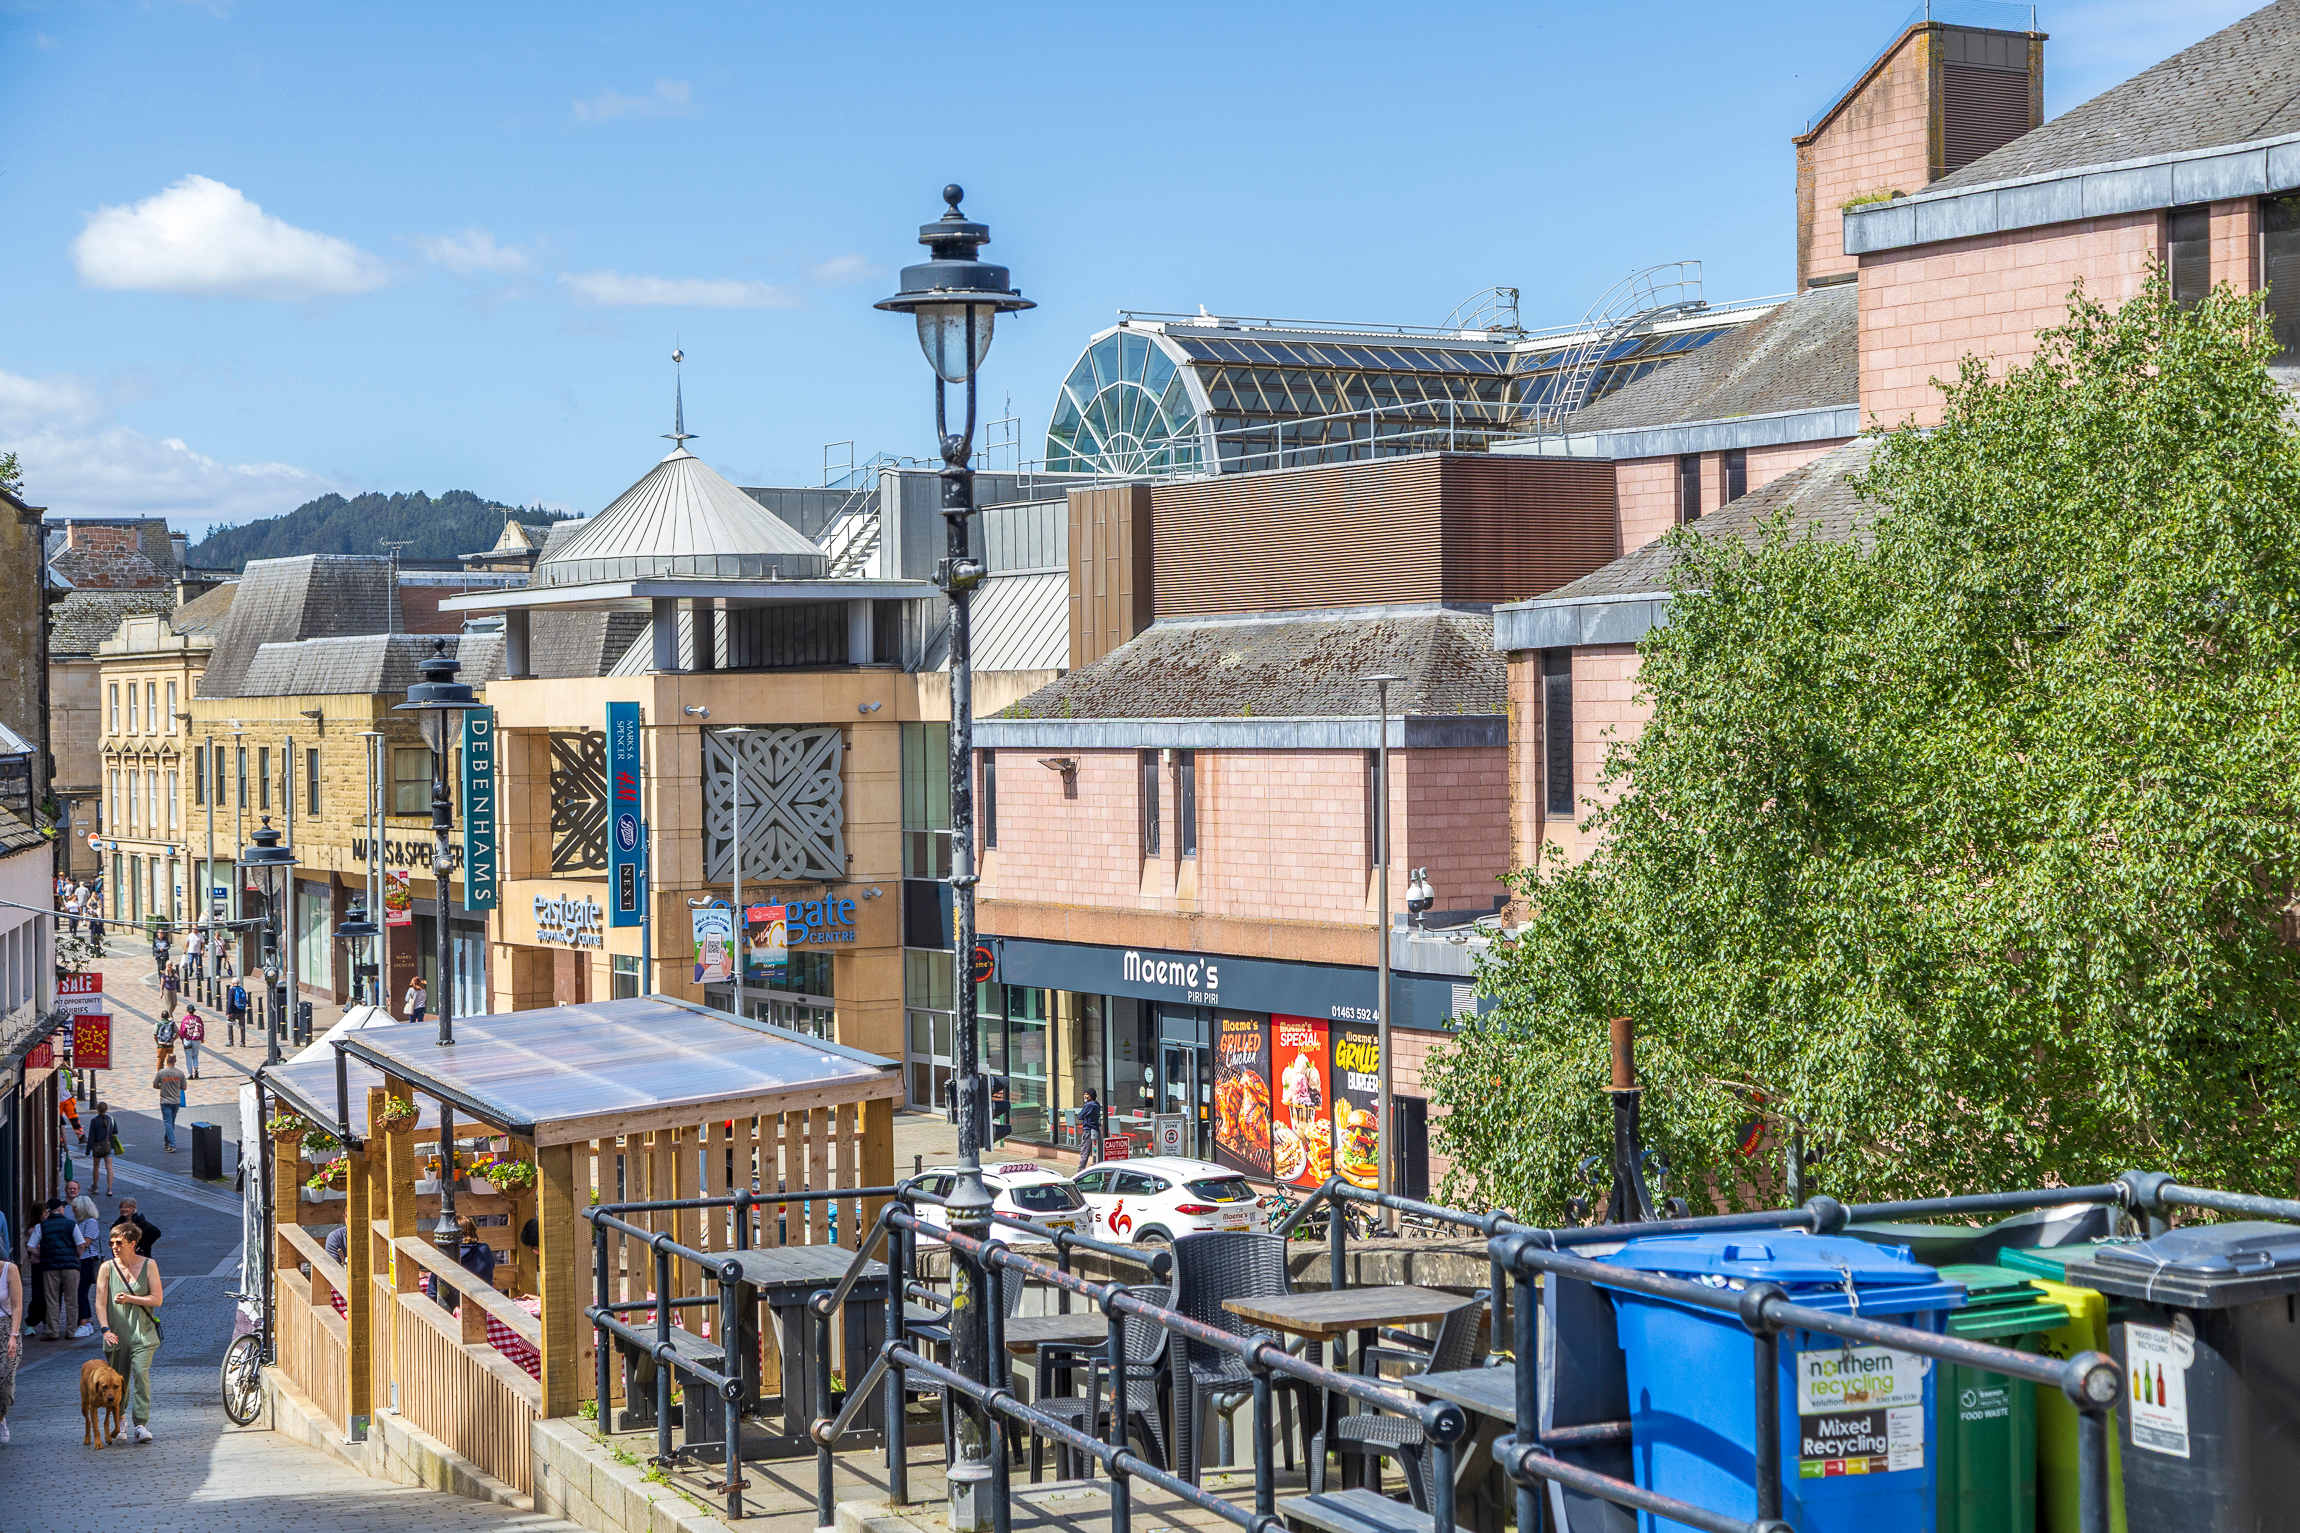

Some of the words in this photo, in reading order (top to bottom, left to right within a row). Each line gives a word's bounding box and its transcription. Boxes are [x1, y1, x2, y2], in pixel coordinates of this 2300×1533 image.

[616, 720, 625, 760] SPENCER
[625, 720, 634, 750] MARKS
[472, 720, 491, 900] DEBENHAMS
[352, 838, 394, 864] MARS
[623, 867, 632, 907] NEXT
[533, 893, 601, 944] eastgate
[809, 931, 855, 944] CENTRE
[1123, 951, 1218, 989] Maeme's
[62, 975, 92, 993] SALE
[1187, 991, 1202, 1002] PIRI
[1203, 992, 1218, 1005] PIRI
[1331, 1005, 1355, 1019] 01463
[1356, 1008, 1371, 1021] 592
[1222, 1018, 1259, 1032] Maeme's
[1220, 1033, 1262, 1053] GRILLED
[1280, 1032, 1319, 1047] SPECIAL
[1346, 1031, 1379, 1045] Maeme's
[1225, 1042, 1257, 1068] Chicken
[1335, 1039, 1379, 1074] GRILLE
[1105, 1139, 1128, 1150] CAUTION
[1811, 1355, 1893, 1377] northern
[1811, 1373, 1894, 1397] recycling
[1960, 1410, 1984, 1421] FOOD
[1984, 1407, 2009, 1418] WASTE
[1819, 1416, 1872, 1438] Mixed
[1803, 1435, 1888, 1457] Recycling
